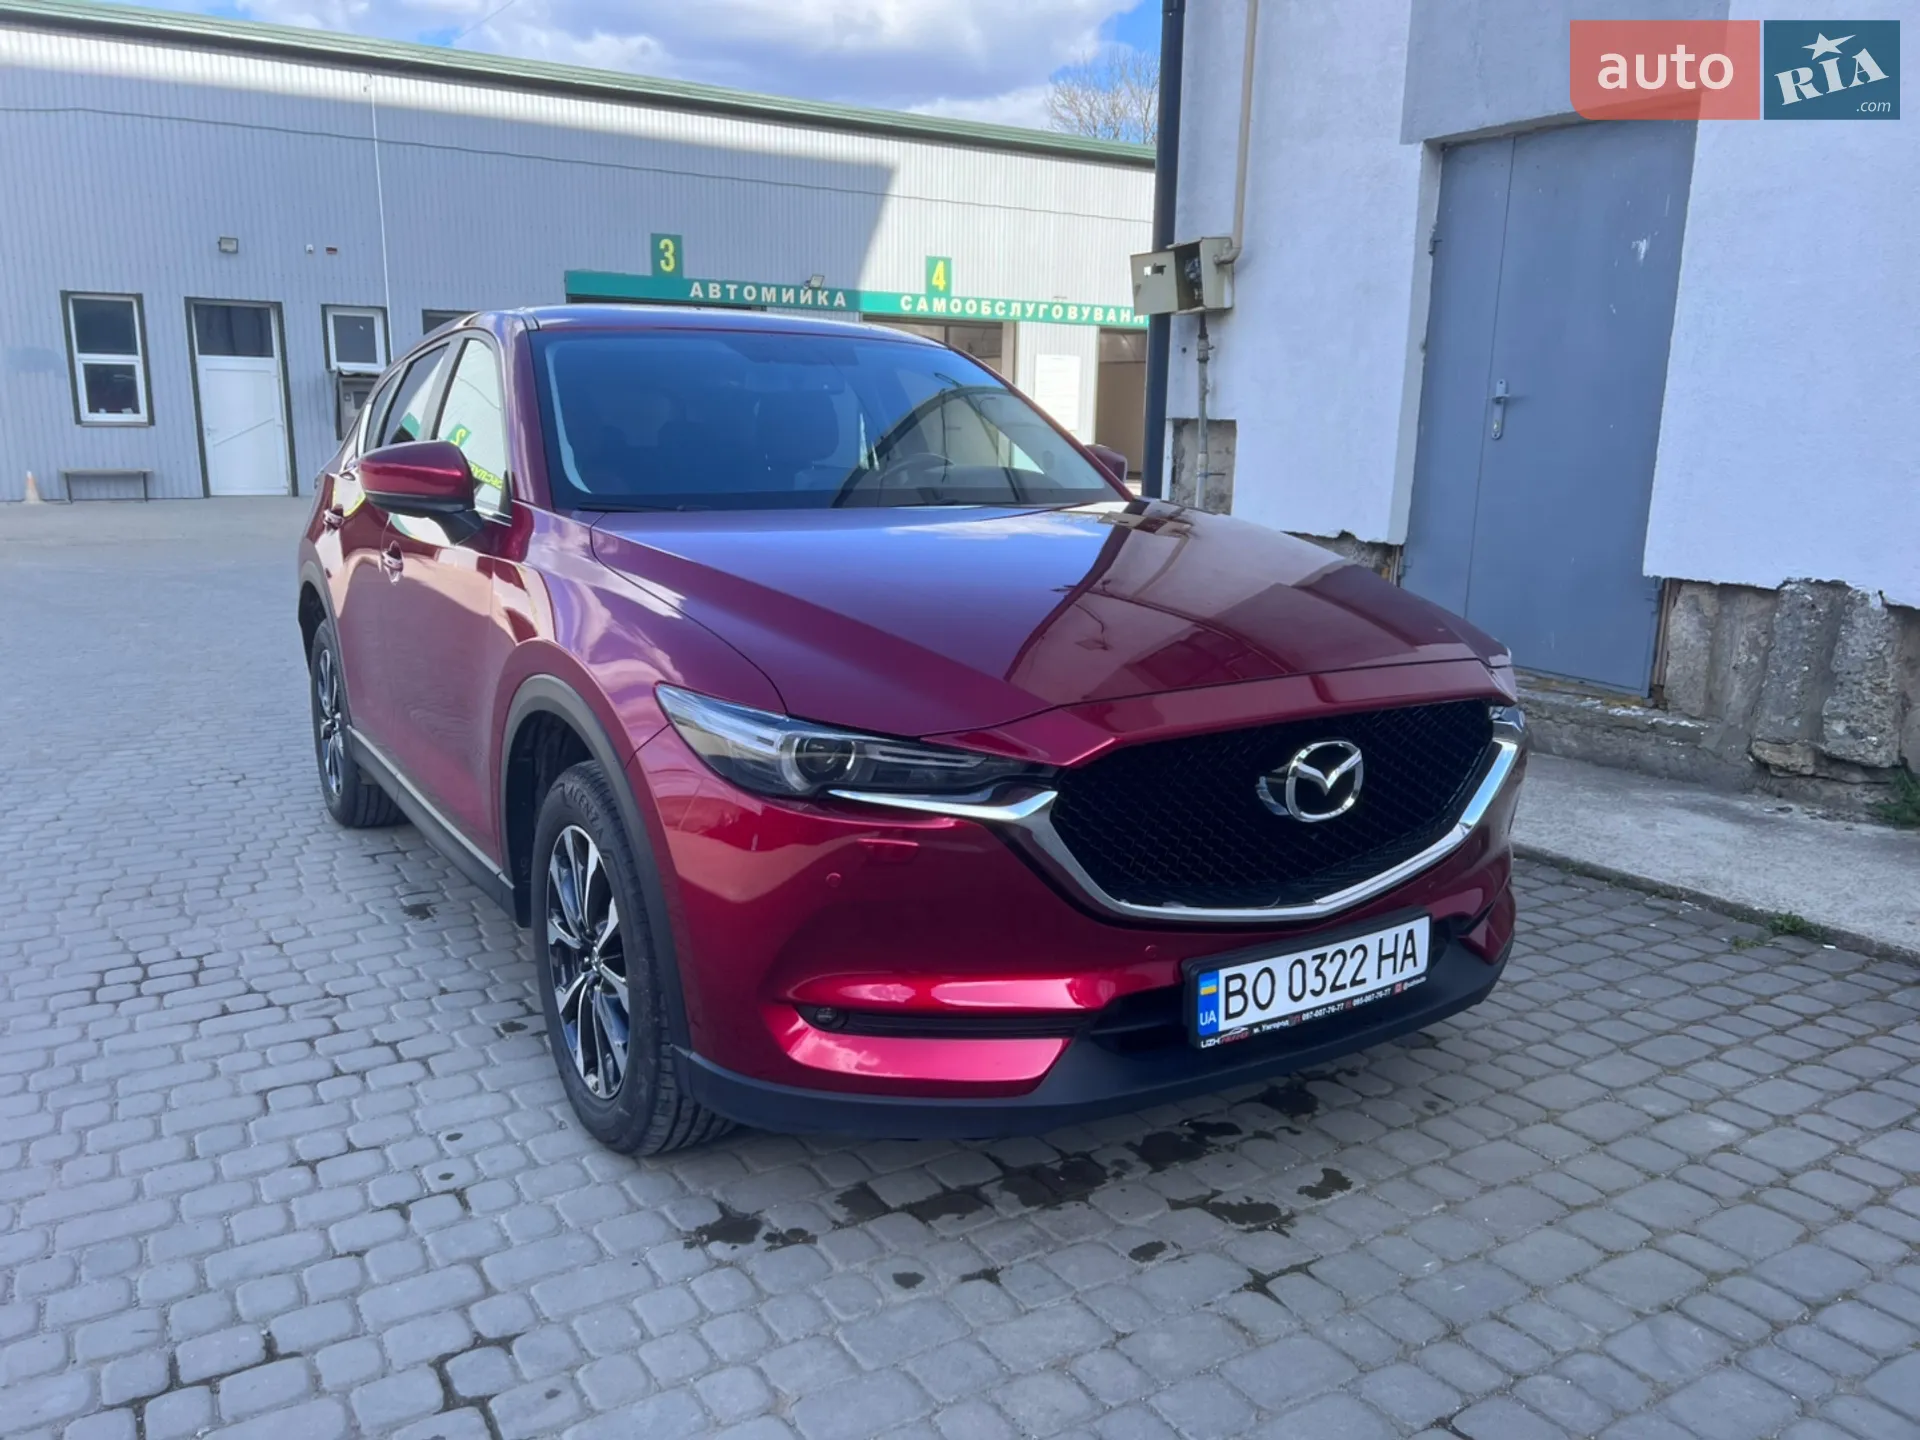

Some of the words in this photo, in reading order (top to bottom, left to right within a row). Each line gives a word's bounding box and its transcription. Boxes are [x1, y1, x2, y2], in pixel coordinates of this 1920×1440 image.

[659, 238, 676, 273] 3
[931, 259, 947, 292] 4
[689, 281, 847, 307] АВТОМИЙКА
[1224, 966, 1276, 1021] BO
[1288, 943, 1368, 1003] 0322
[1377, 928, 1418, 980] HA
[1199, 1009, 1218, 1027] UA
